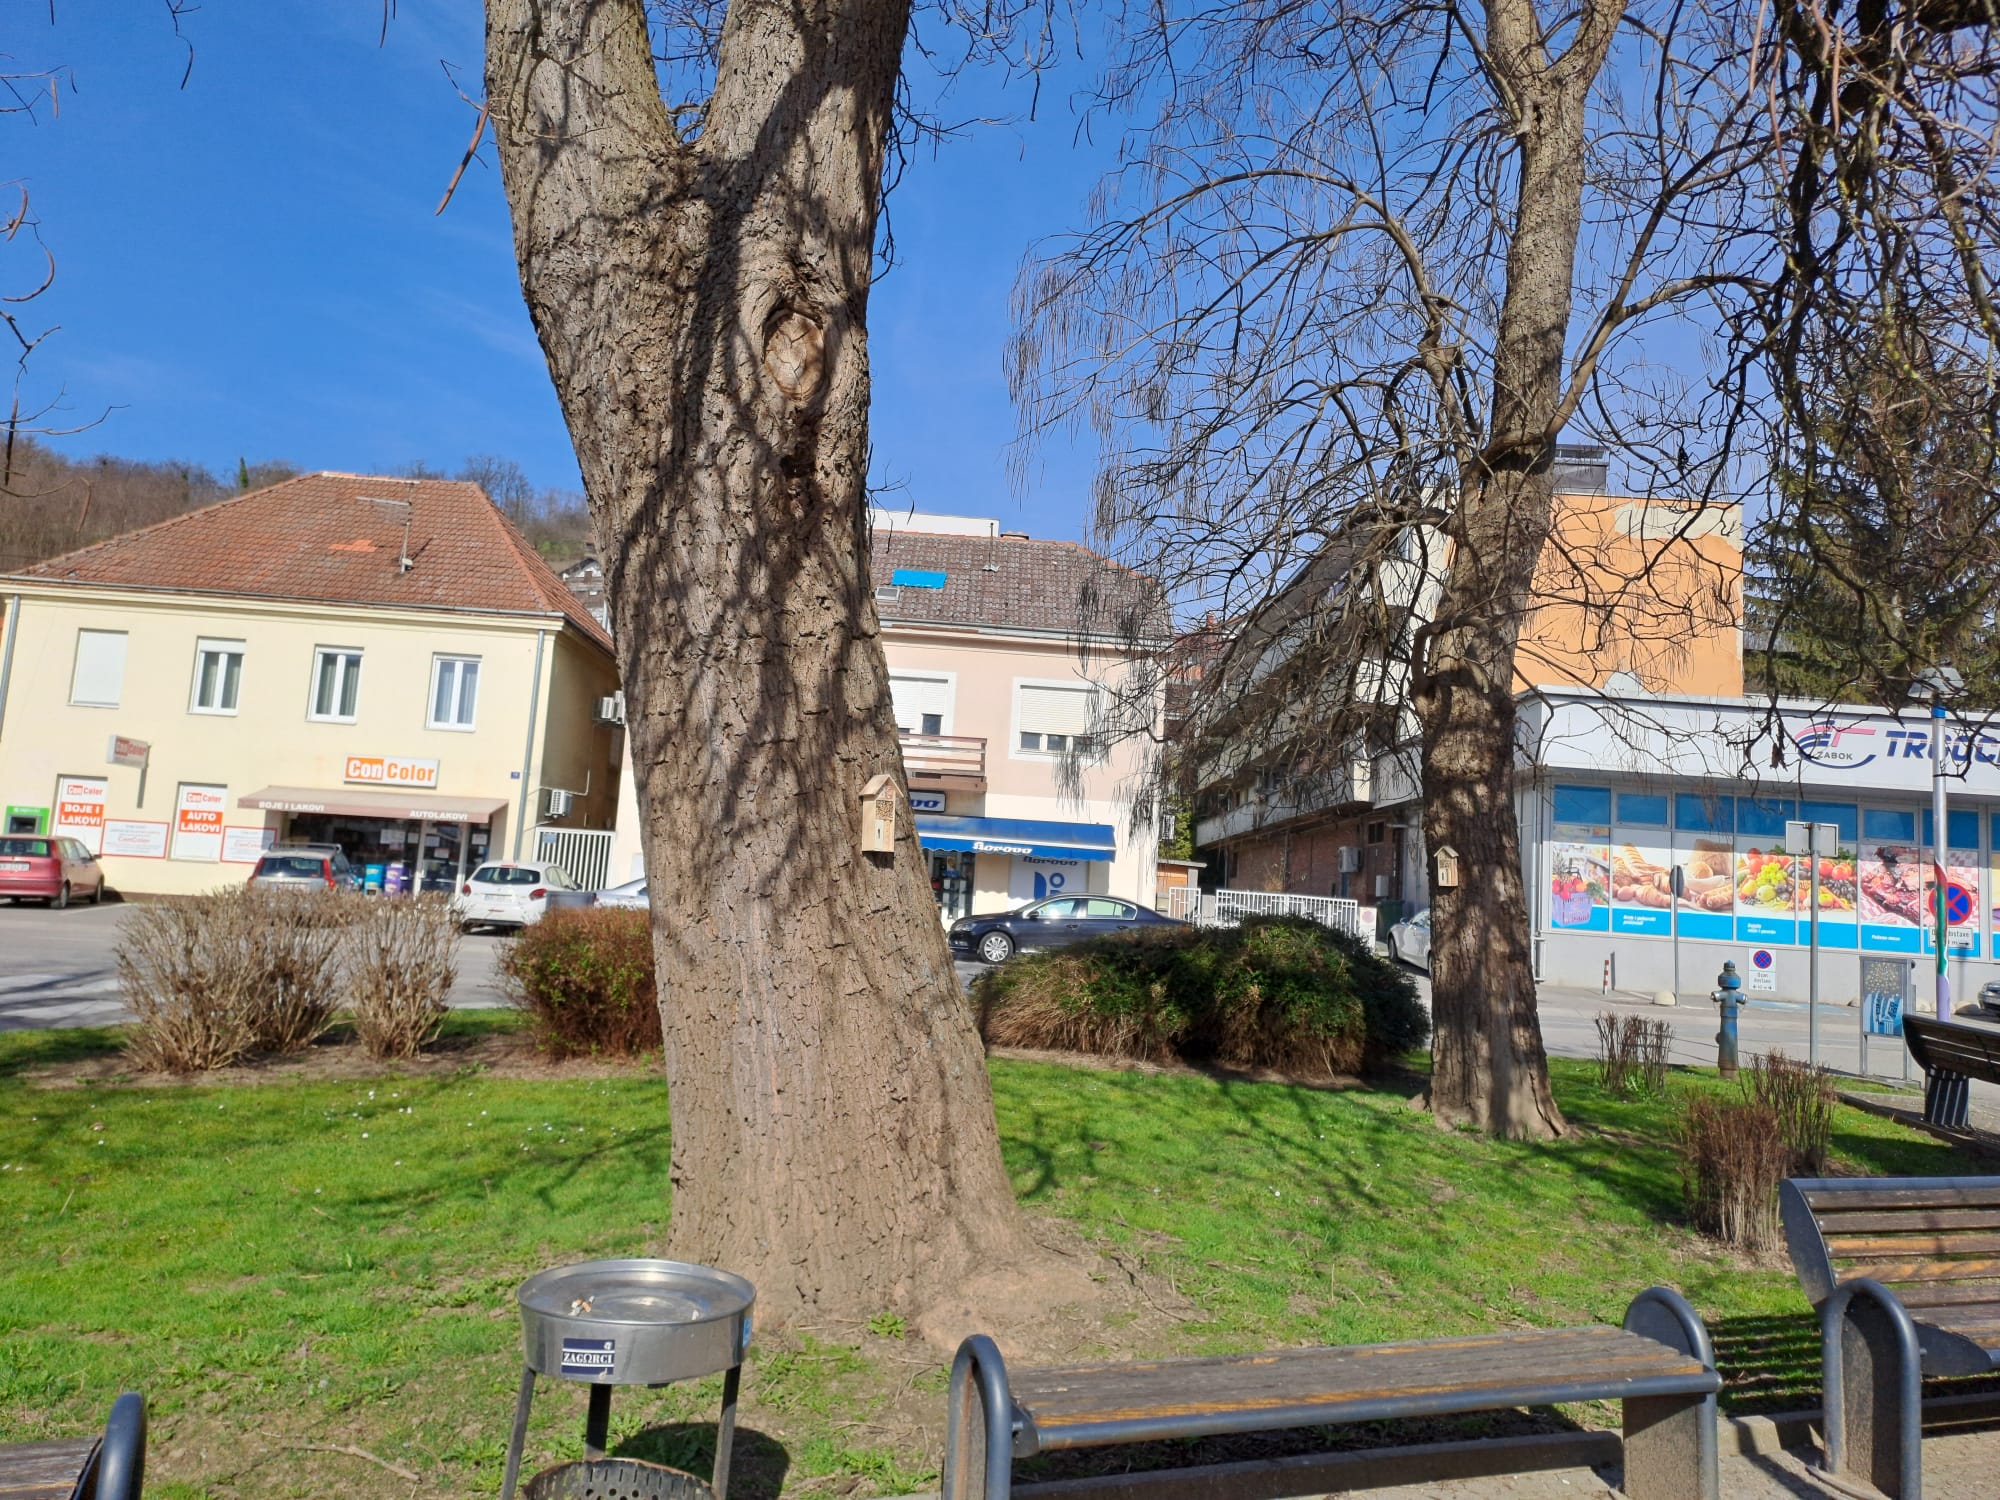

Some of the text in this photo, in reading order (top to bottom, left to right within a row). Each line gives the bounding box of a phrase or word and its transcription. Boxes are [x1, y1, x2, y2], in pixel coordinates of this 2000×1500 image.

[1817, 751, 1853, 761] ZABOK
[349, 759, 435, 781] Con Color
[64, 803, 100, 814] BOJE I
[258, 801, 283, 810] BOJE
[290, 803, 325, 812] LAKOVI
[61, 814, 101, 825] LAKOVI
[187, 811, 217, 821] AUTO
[409, 810, 468, 821] AUTOLAKOVI
[180, 822, 220, 832] LAKOVI
